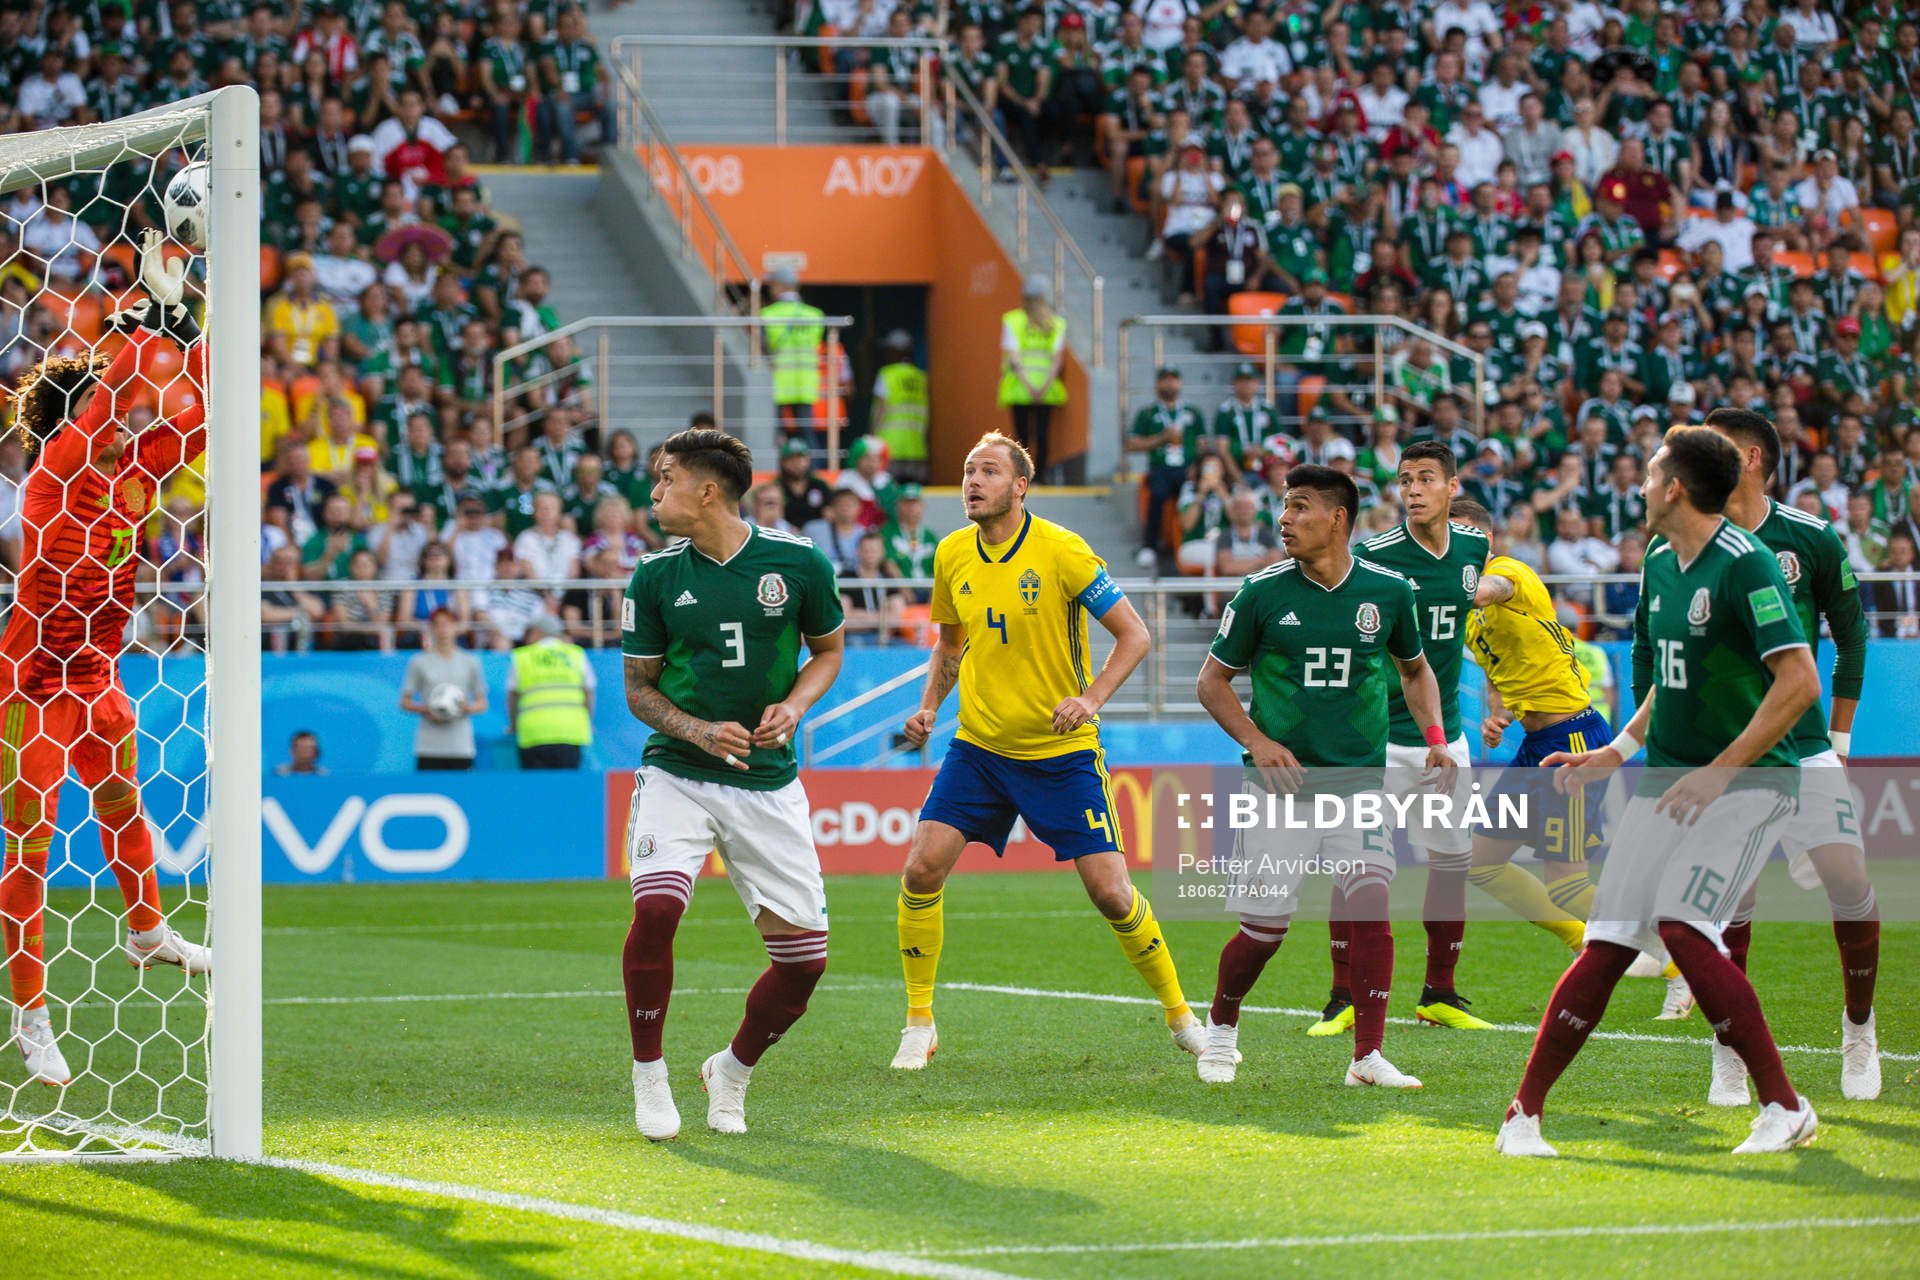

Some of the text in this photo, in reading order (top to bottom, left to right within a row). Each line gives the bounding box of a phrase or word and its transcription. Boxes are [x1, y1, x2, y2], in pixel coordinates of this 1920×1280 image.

[822, 155, 925, 197] A107
[986, 607, 1009, 645] 4
[1428, 605, 1457, 640] 15
[719, 622, 746, 668] 3
[1657, 638, 1688, 689] 16
[1304, 647, 1352, 688] 23
[1084, 808, 1113, 843] 4
[1544, 817, 1565, 853] 9
[1680, 865, 1725, 917] 16
[636, 1008, 661, 1020] FMF
